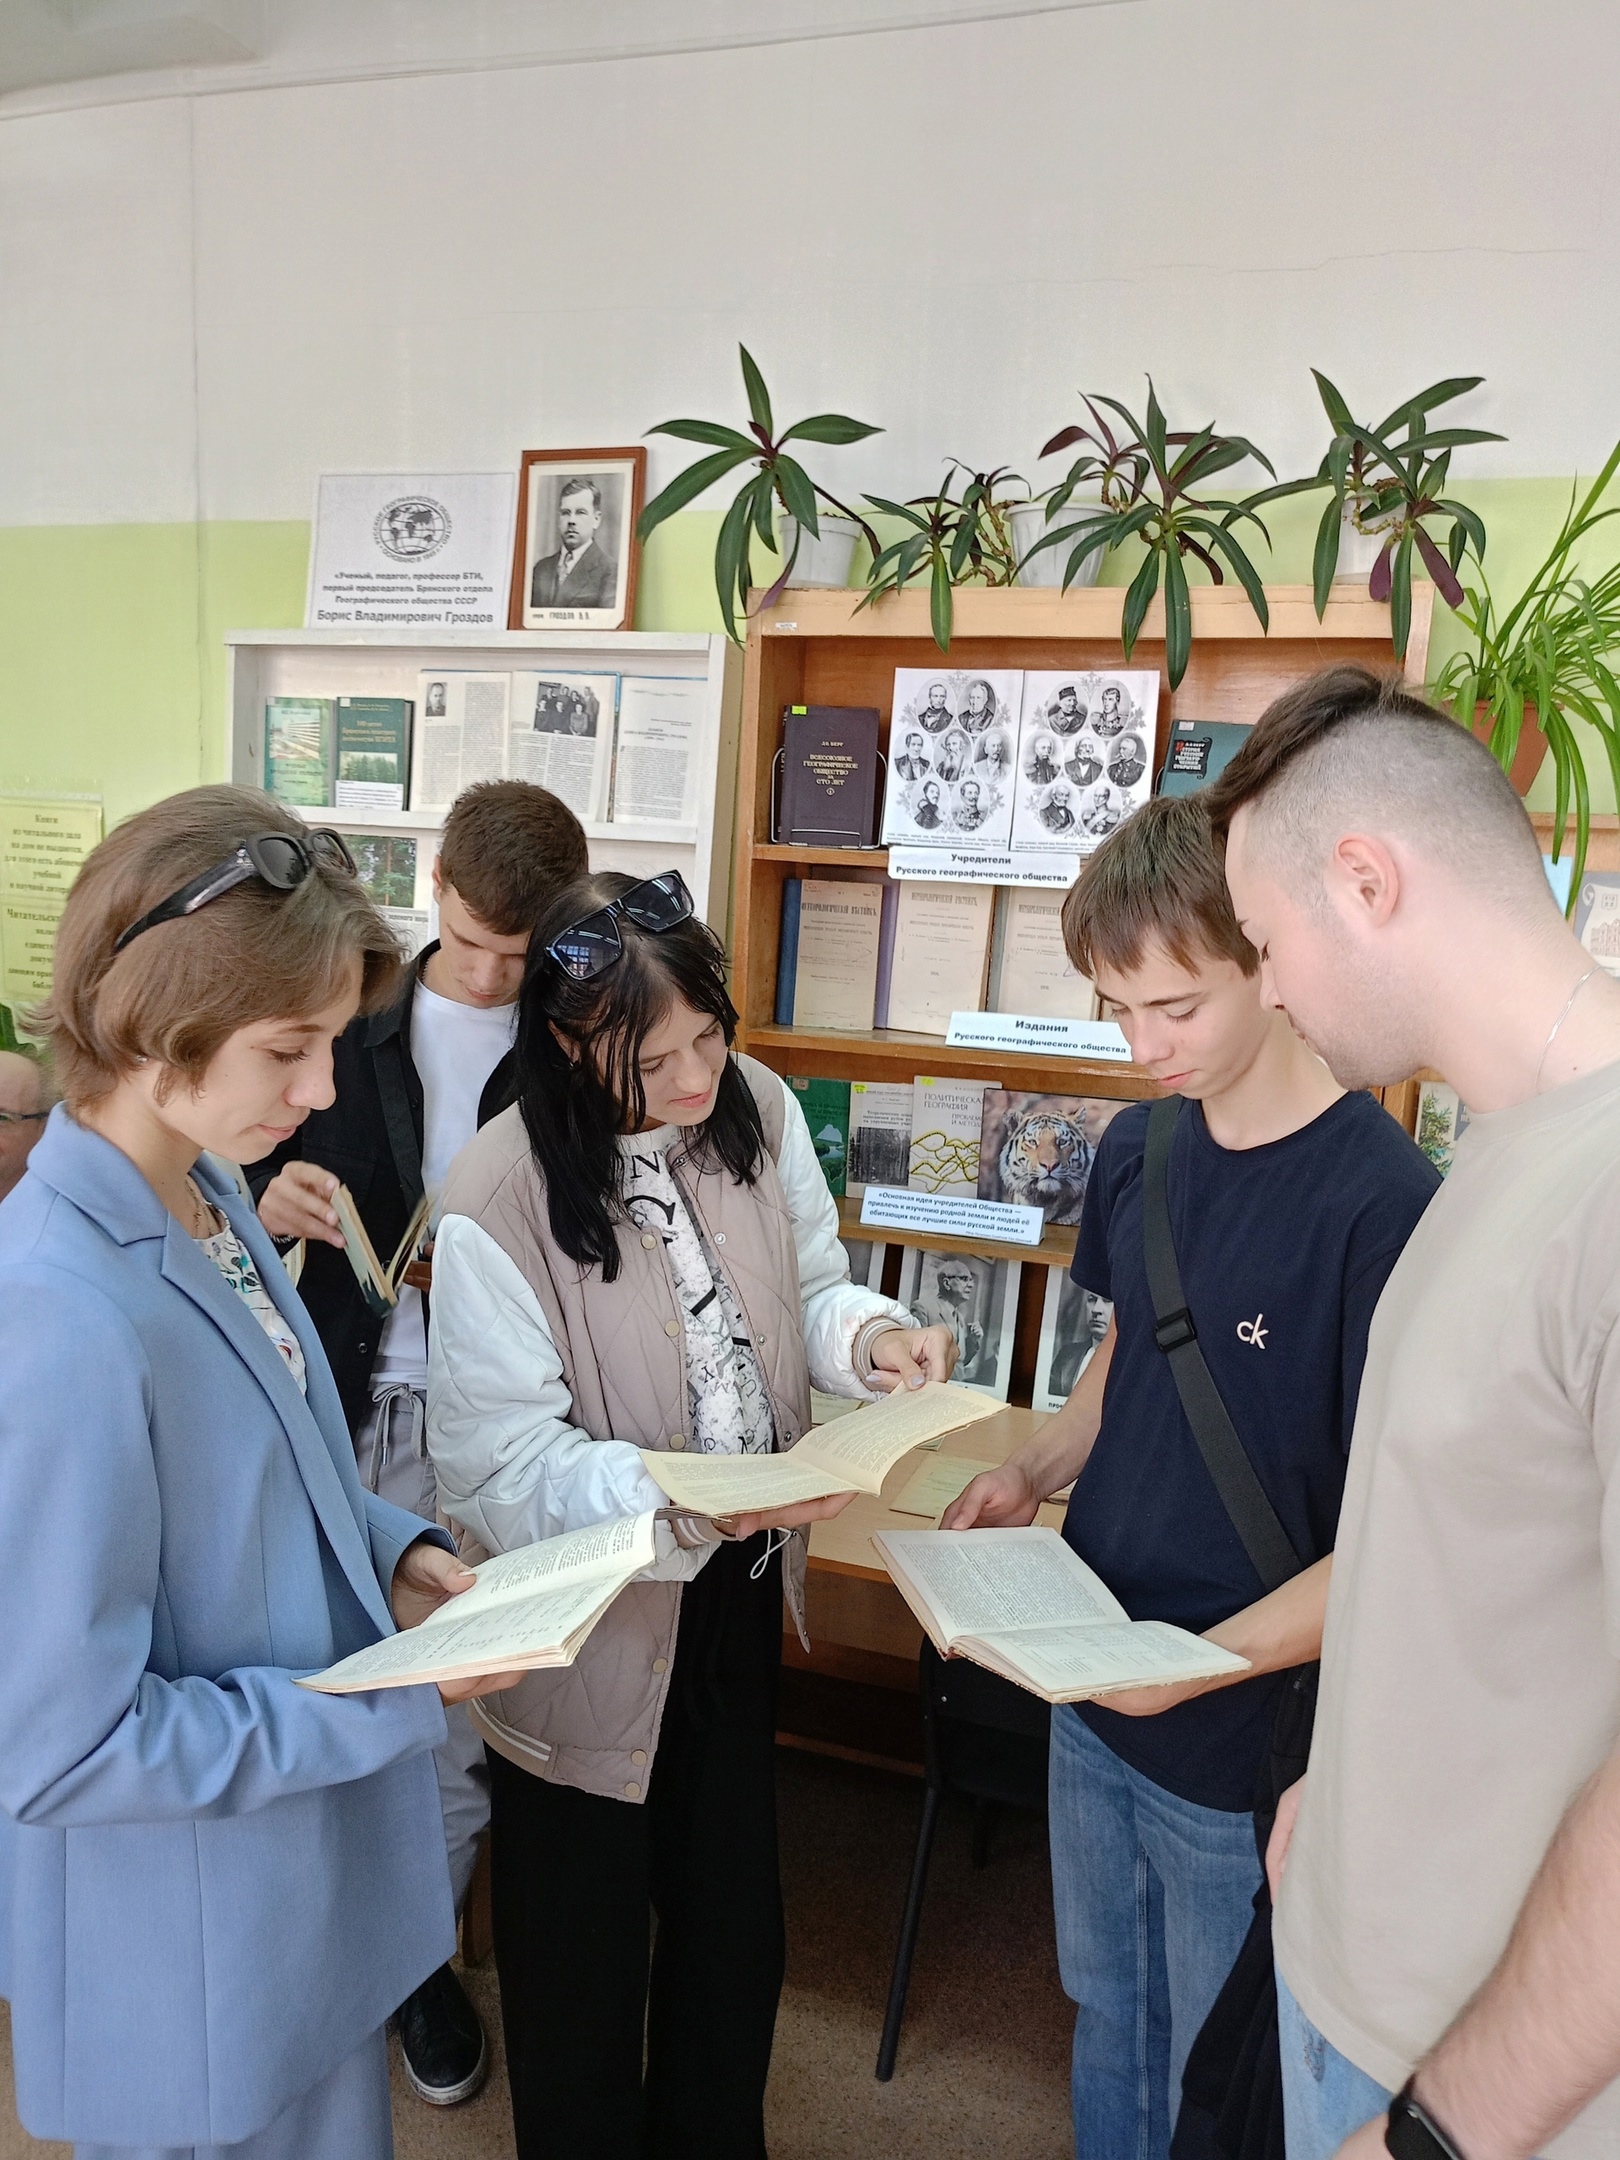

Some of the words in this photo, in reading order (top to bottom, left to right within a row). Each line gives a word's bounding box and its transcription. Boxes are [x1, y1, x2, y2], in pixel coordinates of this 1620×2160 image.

[334, 572, 374, 581] «Ученый,
[375, 573, 411, 581] педагог,
[412, 573, 461, 581] профессор
[322, 584, 354, 593] первый
[355, 585, 415, 594] председатель
[416, 585, 461, 594] Брянского
[462, 586, 493, 594] отдела
[334, 596, 410, 605] Географического
[411, 597, 453, 606] общества
[454, 597, 478, 605] СССР
[317, 610, 352, 621] Борис
[354, 610, 442, 623] Владимирович
[445, 612, 493, 624] Гроздов
[951, 853, 1012, 865] Учредители
[896, 866, 937, 876] Русского
[939, 869, 1020, 881] географического
[1022, 872, 1068, 882] общества
[1015, 1020, 1069, 1033] Издания
[954, 1031, 995, 1042] Русского
[997, 1036, 1079, 1050] географического
[1081, 1043, 1127, 1054] общества
[924, 1101, 968, 1111] ГЕОГРАФИЯ
[951, 1113, 981, 1121] ПРОБЛЕМ
[878, 1192, 915, 1202] «Основная
[915, 1196, 933, 1204] идея
[933, 1198, 977, 1210] учредителей
[978, 1203, 1013, 1214] Общества
[867, 1200, 900, 1210] привлечь
[905, 1205, 939, 1216] изучению
[939, 1208, 966, 1218] родной
[967, 1212, 990, 1220] земли
[996, 1215, 1020, 1226] людей
[869, 1209, 908, 1221] обитающих
[909, 1214, 921, 1222] все
[921, 1216, 948, 1225] лучшие
[948, 1218, 967, 1227] силы
[966, 1220, 995, 1232] русской
[996, 1225, 1025, 1234] земли.»
